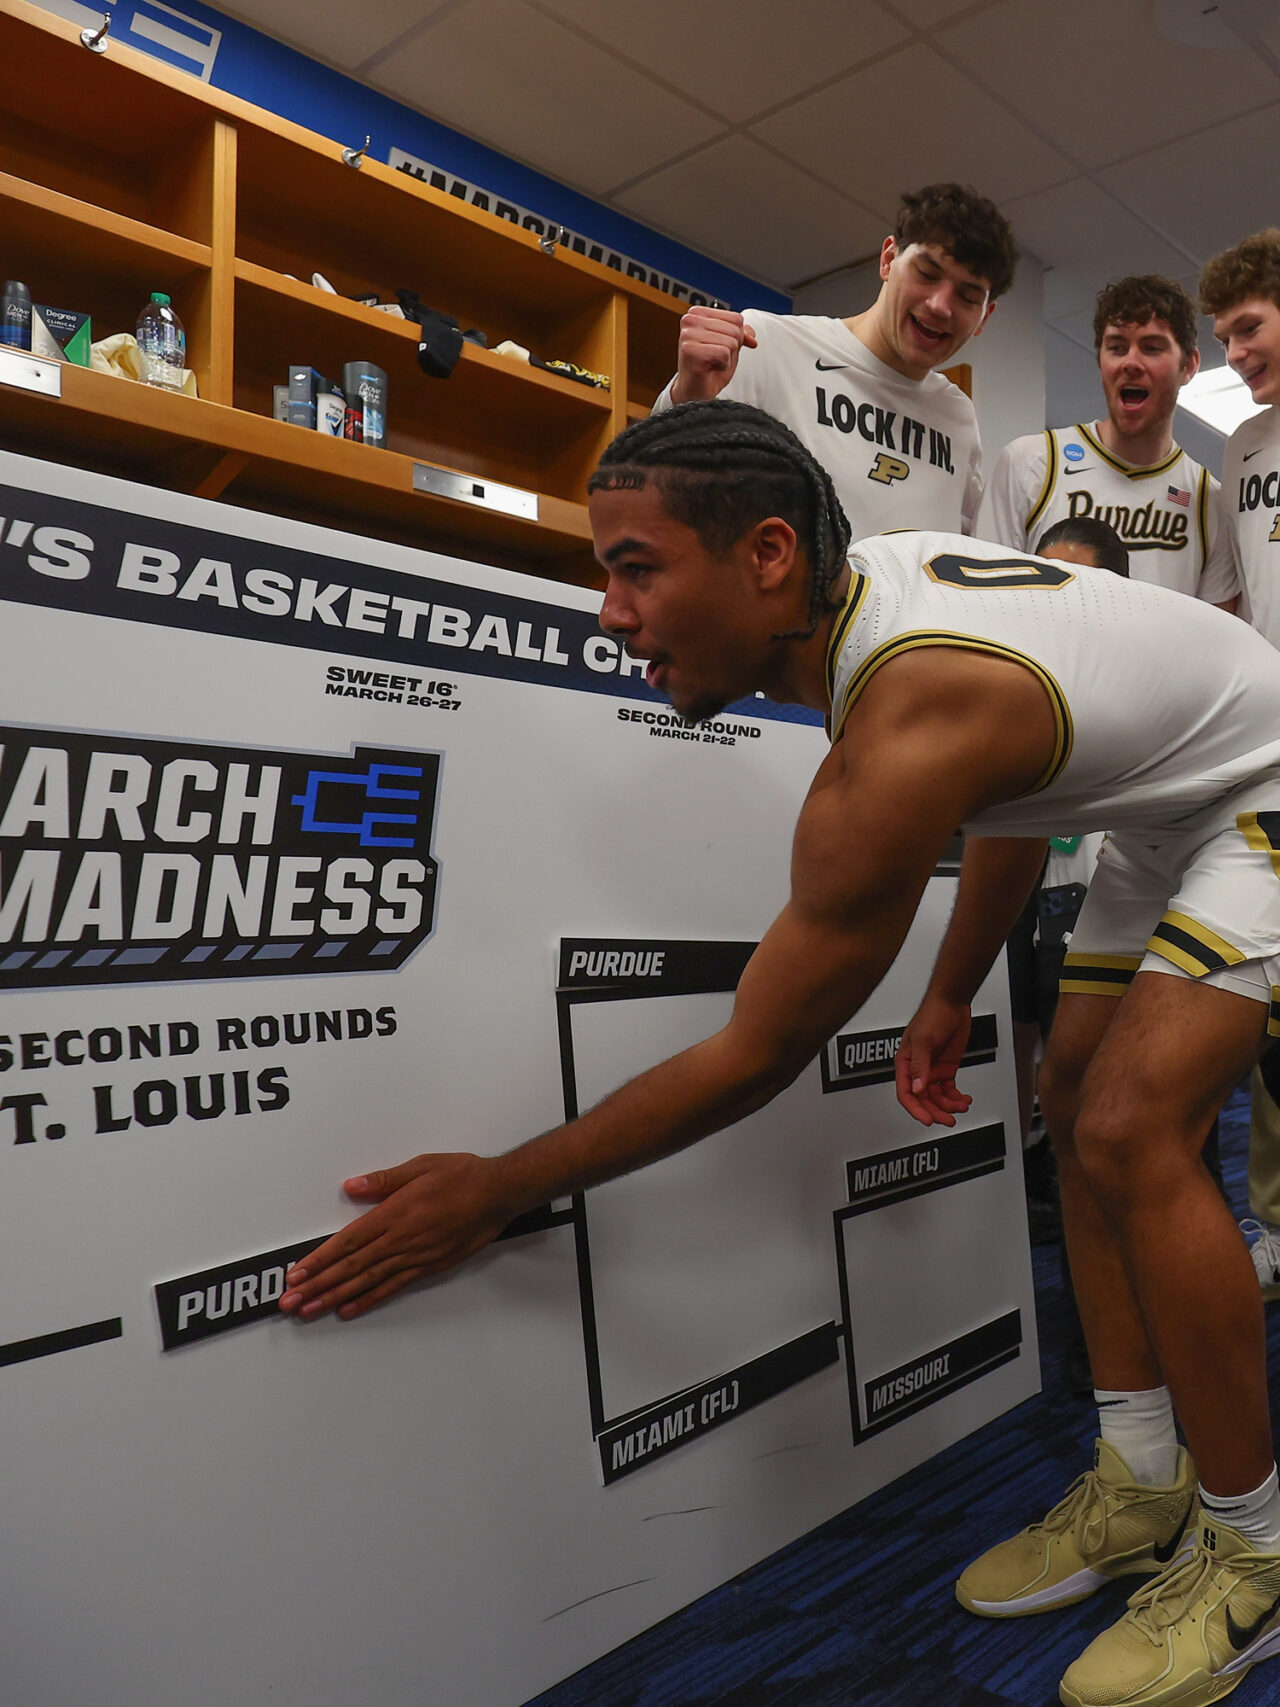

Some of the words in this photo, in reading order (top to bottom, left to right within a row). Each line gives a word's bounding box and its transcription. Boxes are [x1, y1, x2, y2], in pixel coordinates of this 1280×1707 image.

[46, 309, 76, 321] Degree
[816, 386, 896, 450] LOCK
[901, 416, 926, 459] IT
[929, 427, 955, 475] IN.
[923, 553, 1076, 591] 0
[116, 542, 569, 666] BASKETBALL
[325, 683, 402, 703] MARCH
[407, 695, 461, 711] 26-27
[326, 666, 422, 692] SWEET
[650, 727, 700, 741] MARCH
[703, 734, 736, 746] 21-22
[701, 720, 761, 738] ROUND
[0, 744, 282, 845] ARCH
[569, 951, 665, 977] PURDUE
[217, 1006, 397, 1051] ROUNDS
[93, 1066, 290, 1134] LOUIS
[854, 1157, 909, 1193] MIAMI
[913, 1148, 939, 1177] (FL)
[177, 1262, 298, 1331] PURD
[872, 1354, 950, 1413] MISSOURI
[612, 1403, 695, 1470] MIAMI
[701, 1380, 739, 1425] (FL)
